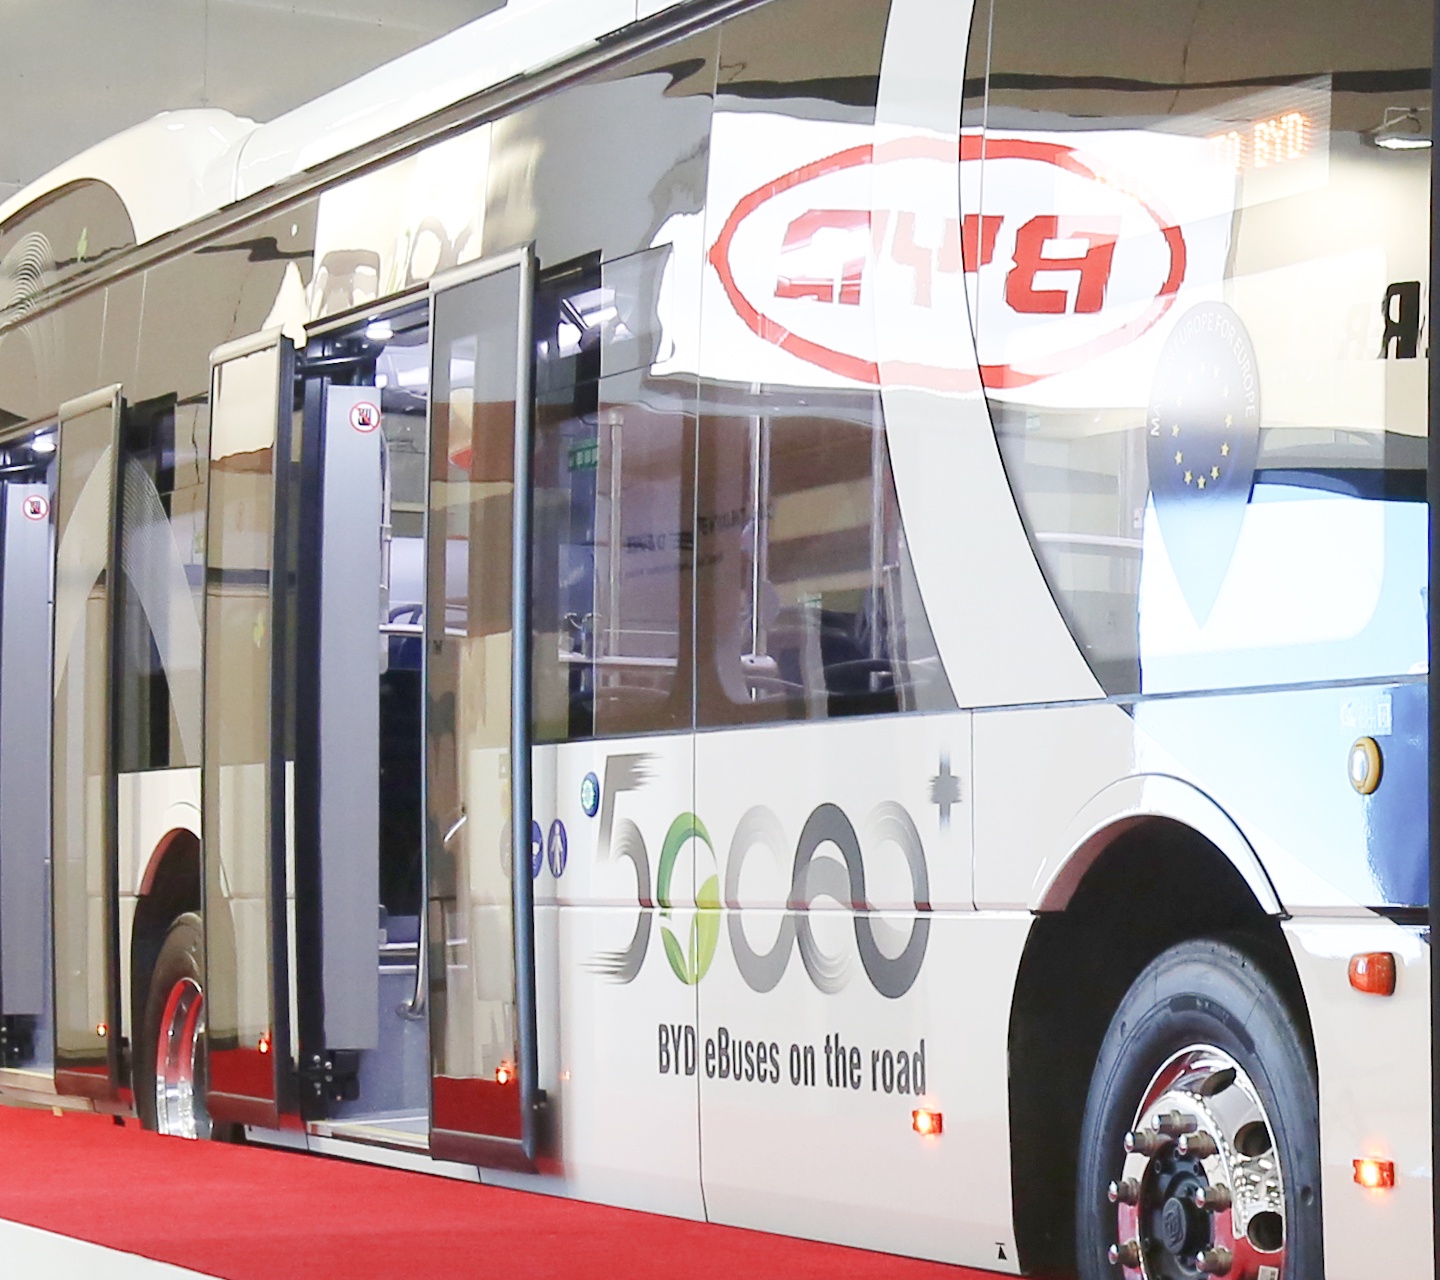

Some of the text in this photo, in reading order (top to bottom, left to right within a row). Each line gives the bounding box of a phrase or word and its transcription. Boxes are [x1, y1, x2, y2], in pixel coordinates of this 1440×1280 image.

[658, 1023, 927, 1097] BYD eBuses on the road
